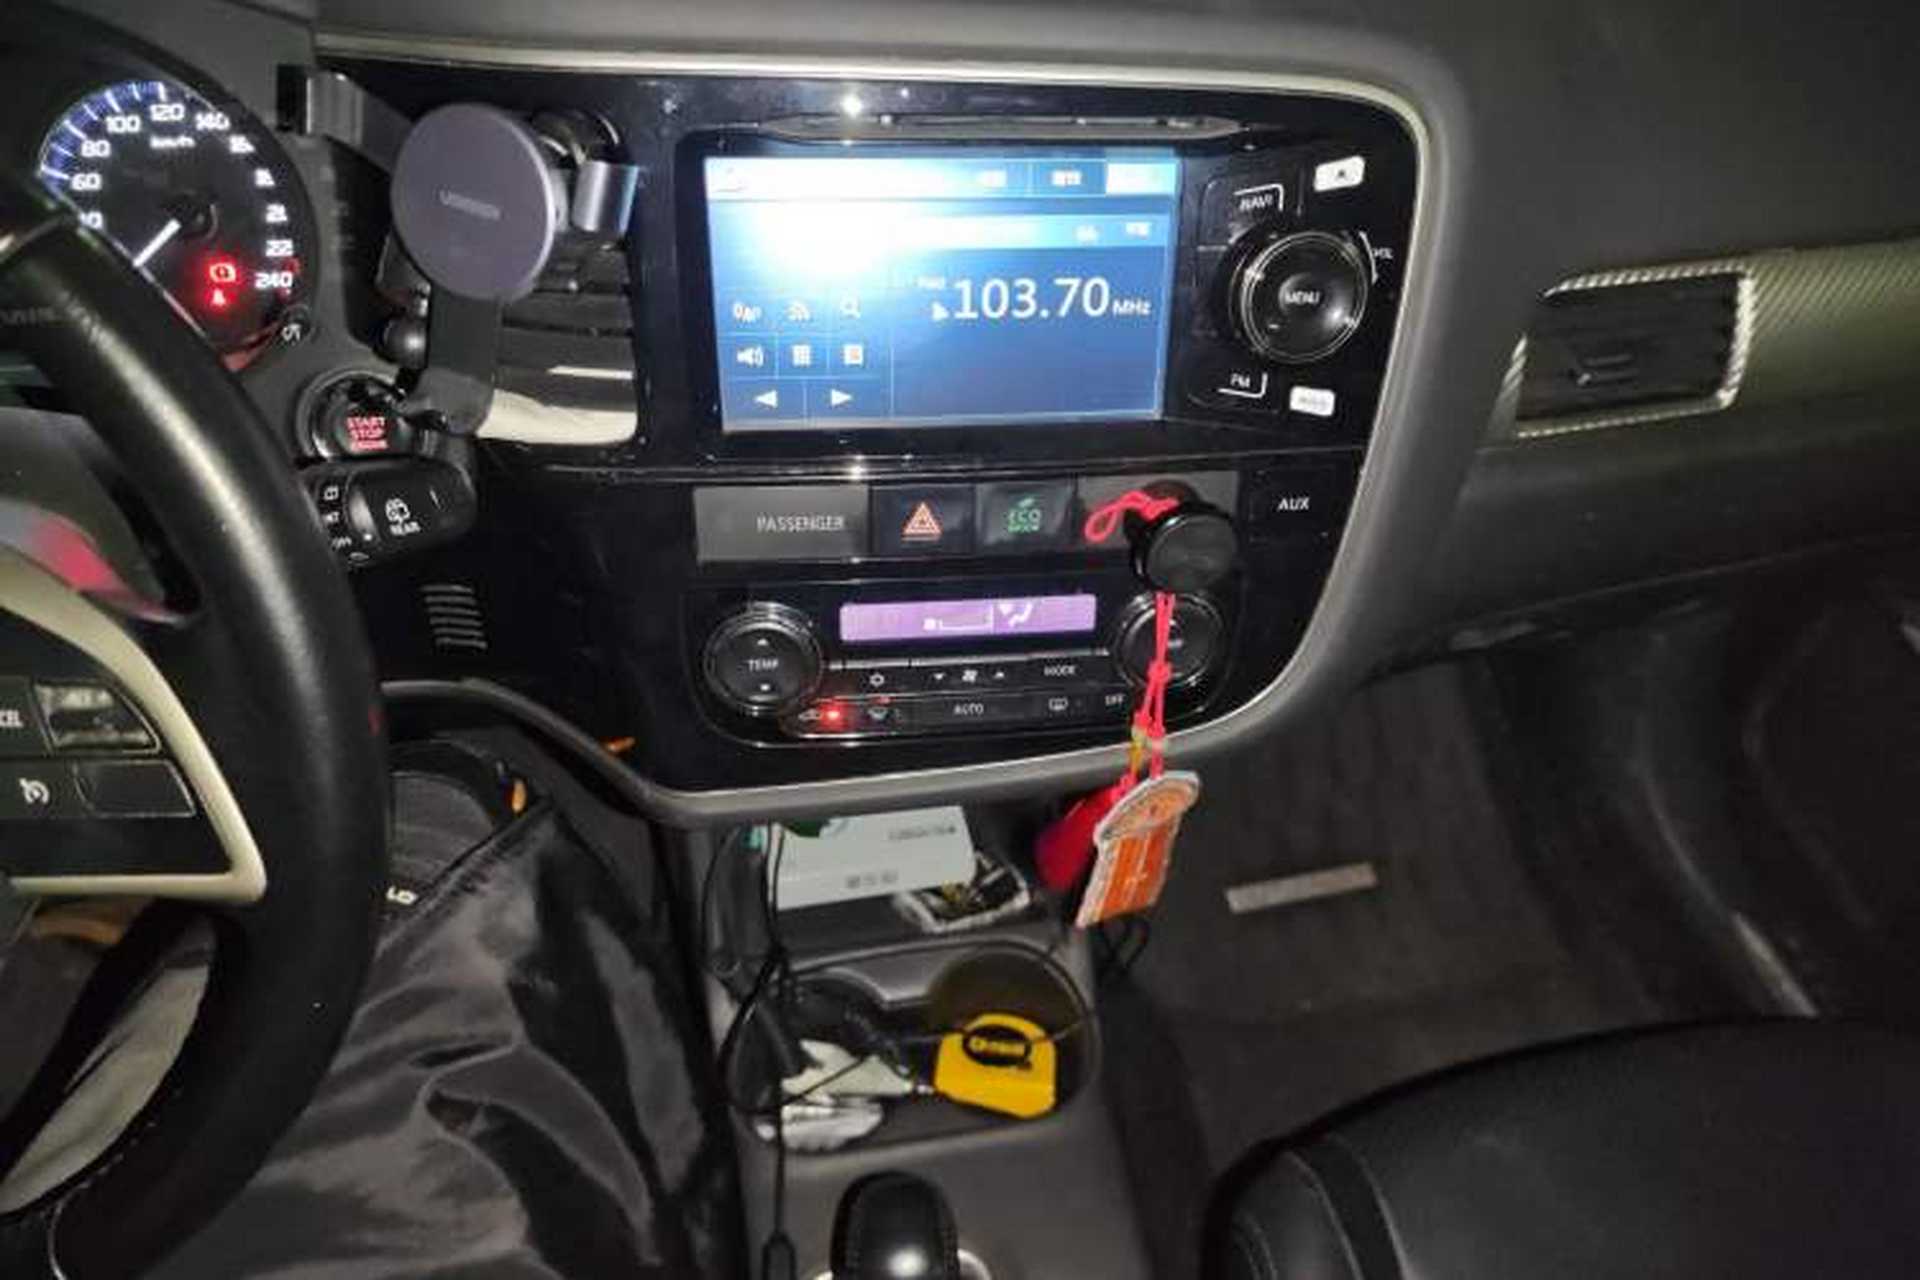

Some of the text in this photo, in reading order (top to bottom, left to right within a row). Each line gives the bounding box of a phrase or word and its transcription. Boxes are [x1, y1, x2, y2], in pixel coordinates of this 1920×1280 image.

[150, 103, 185, 121] 120
[106, 115, 140, 133] 100
[195, 112, 230, 131] 140
[81, 139, 110, 157] 80
[71, 172, 101, 190] 60
[254, 271, 294, 291] 240
[953, 276, 1110, 320] 103.70
[1112, 299, 1152, 318] MHz
[1284, 290, 1321, 304] MENU
[1230, 373, 1251, 388] FM
[1278, 497, 1310, 511] AUX
[756, 515, 846, 533] PASSENGER
[748, 659, 780, 672] TEMP
[952, 702, 984, 716] AUTO
